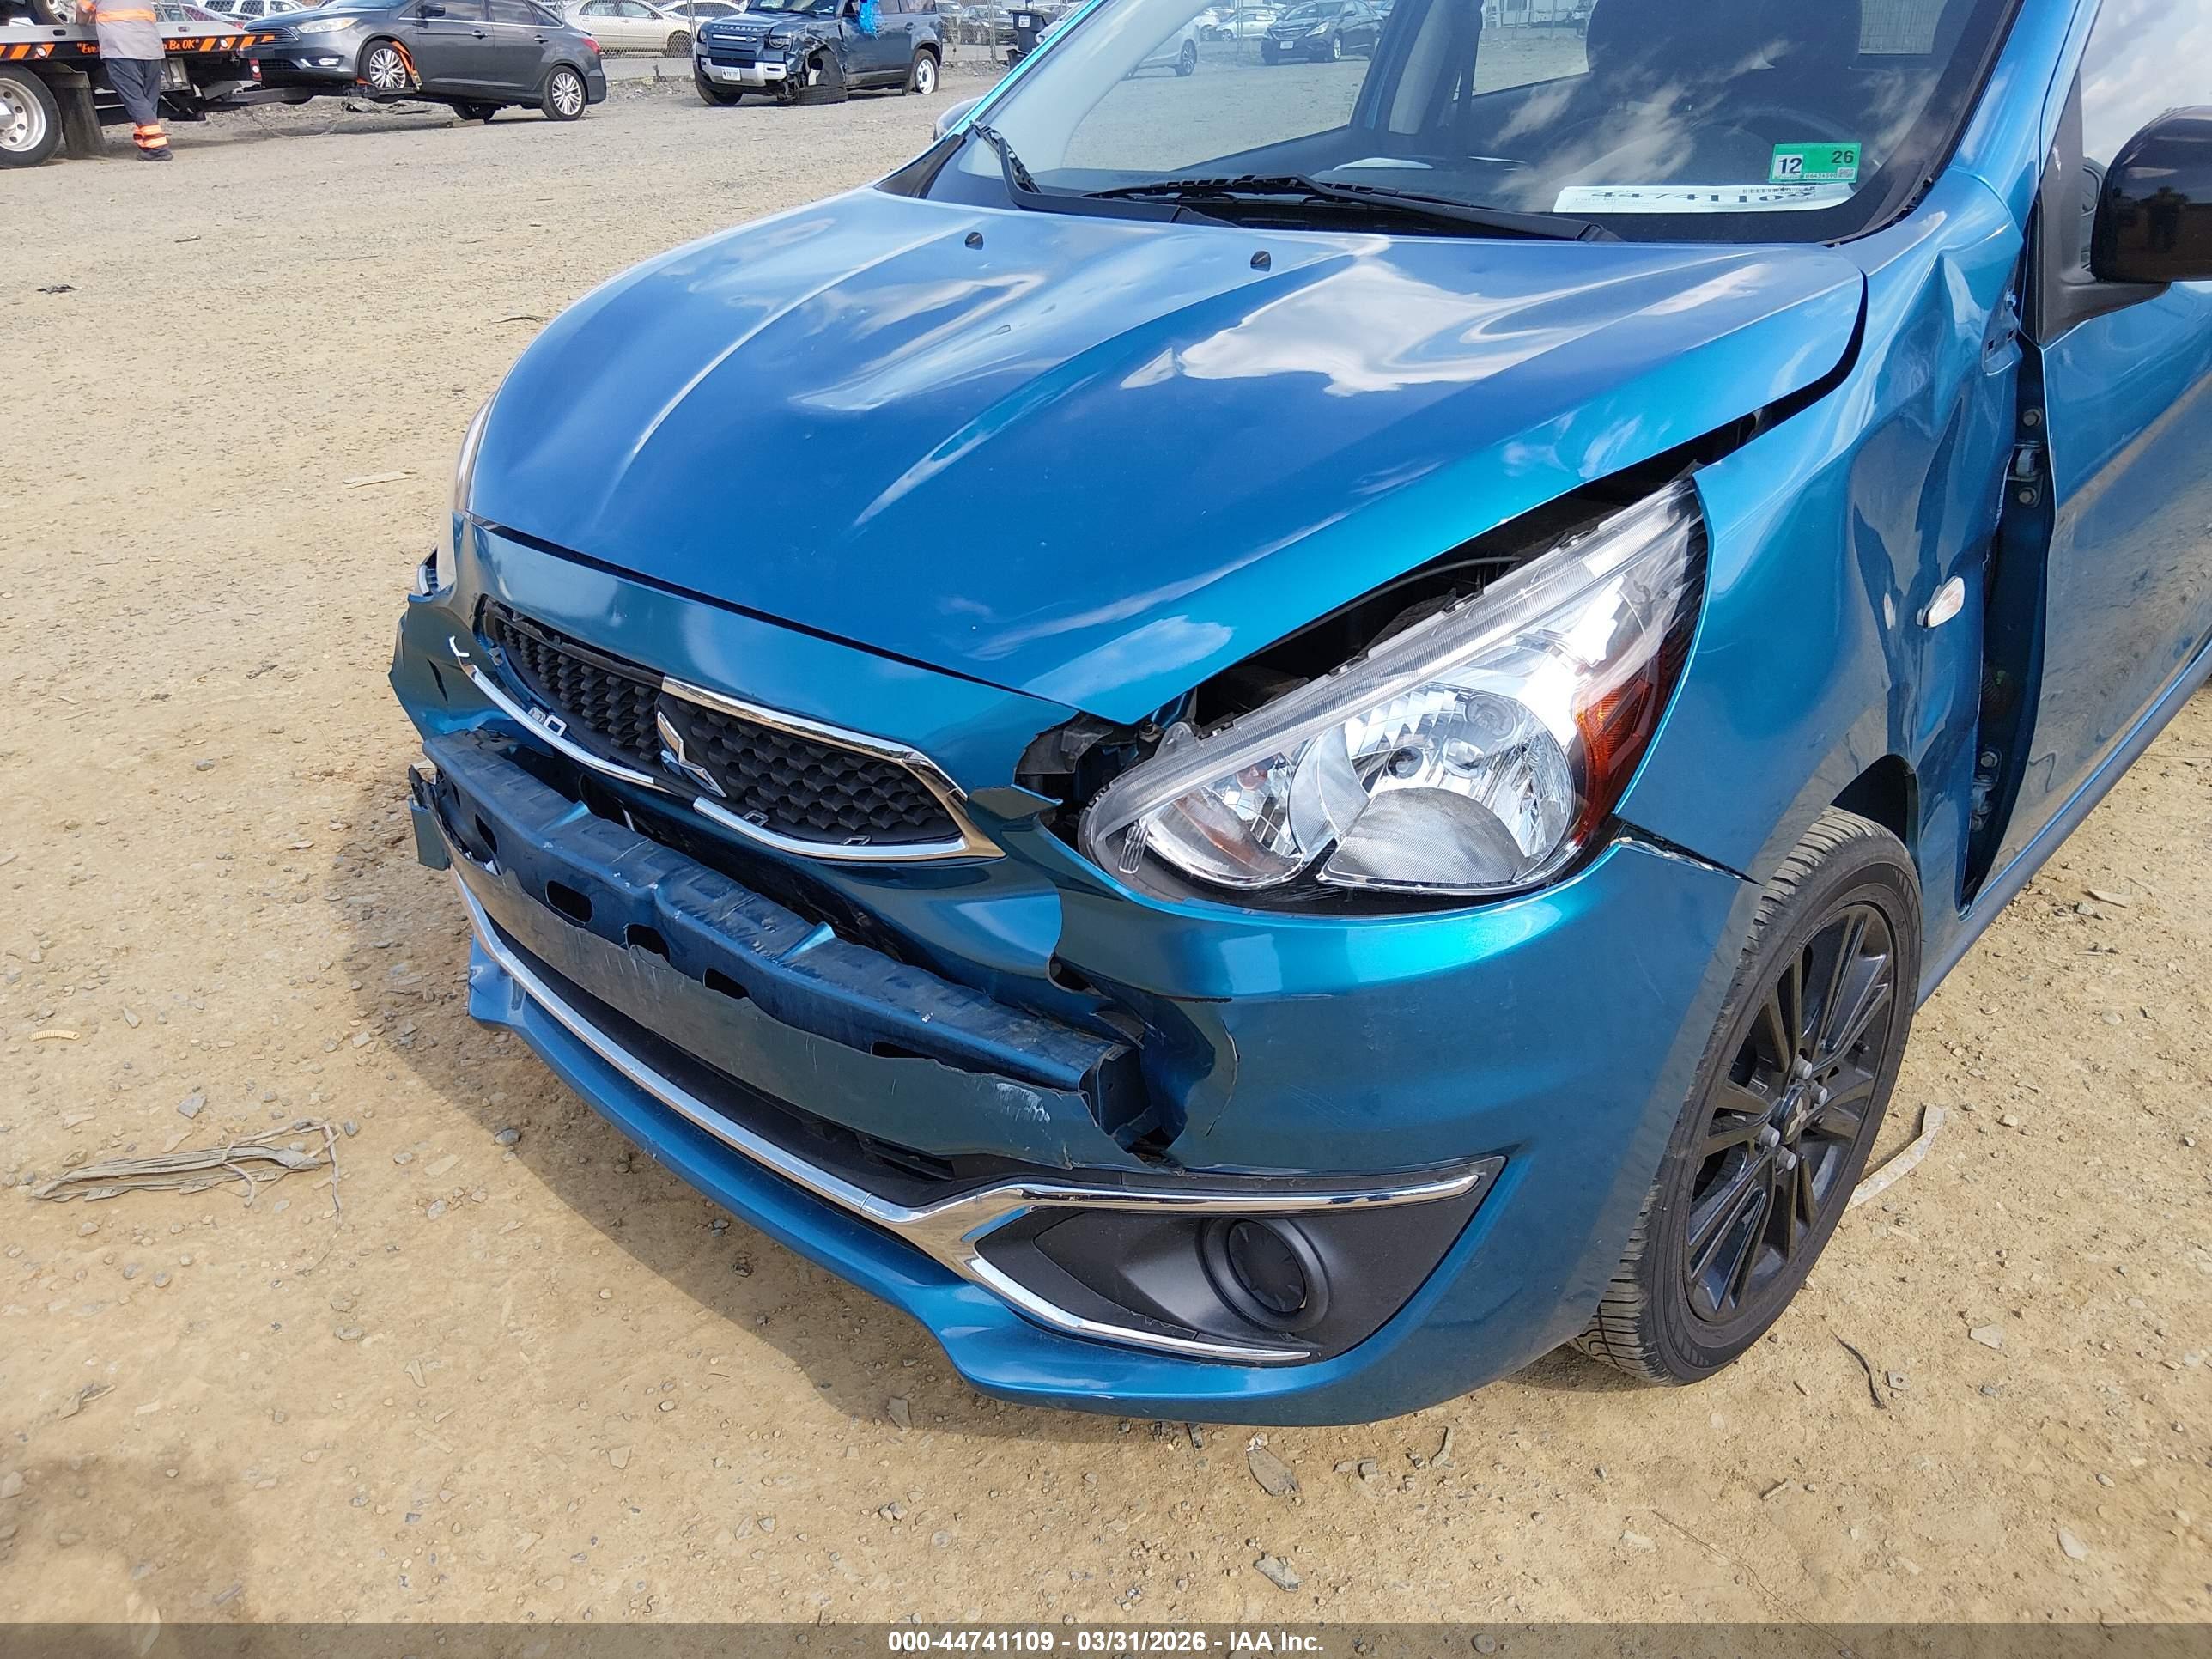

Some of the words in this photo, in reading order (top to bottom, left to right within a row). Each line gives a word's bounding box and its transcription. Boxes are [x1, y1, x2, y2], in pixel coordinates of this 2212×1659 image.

[169, 40, 180, 50] Be
[1832, 149, 1854, 164] 26
[1779, 157, 1802, 174] 12
